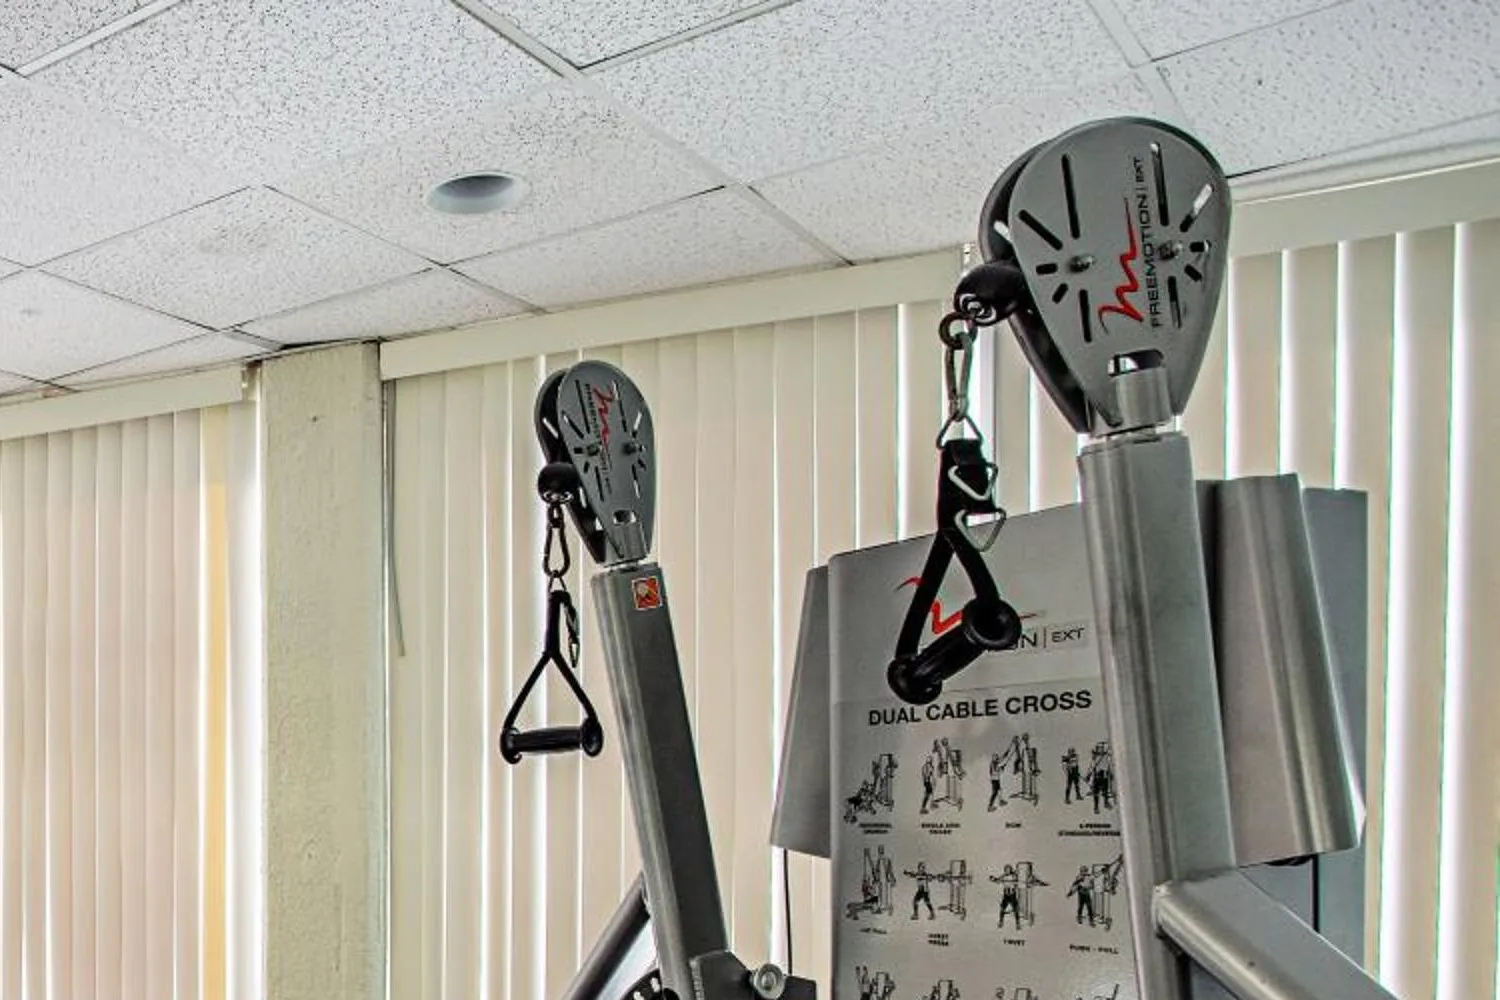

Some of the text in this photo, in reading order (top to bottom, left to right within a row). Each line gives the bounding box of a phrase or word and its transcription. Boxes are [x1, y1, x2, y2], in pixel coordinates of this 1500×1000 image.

[1137, 193, 1163, 327] FREEMOTION
[1051, 627, 1085, 644] EXT
[868, 689, 1093, 726] DUAL CABLE CROSS
